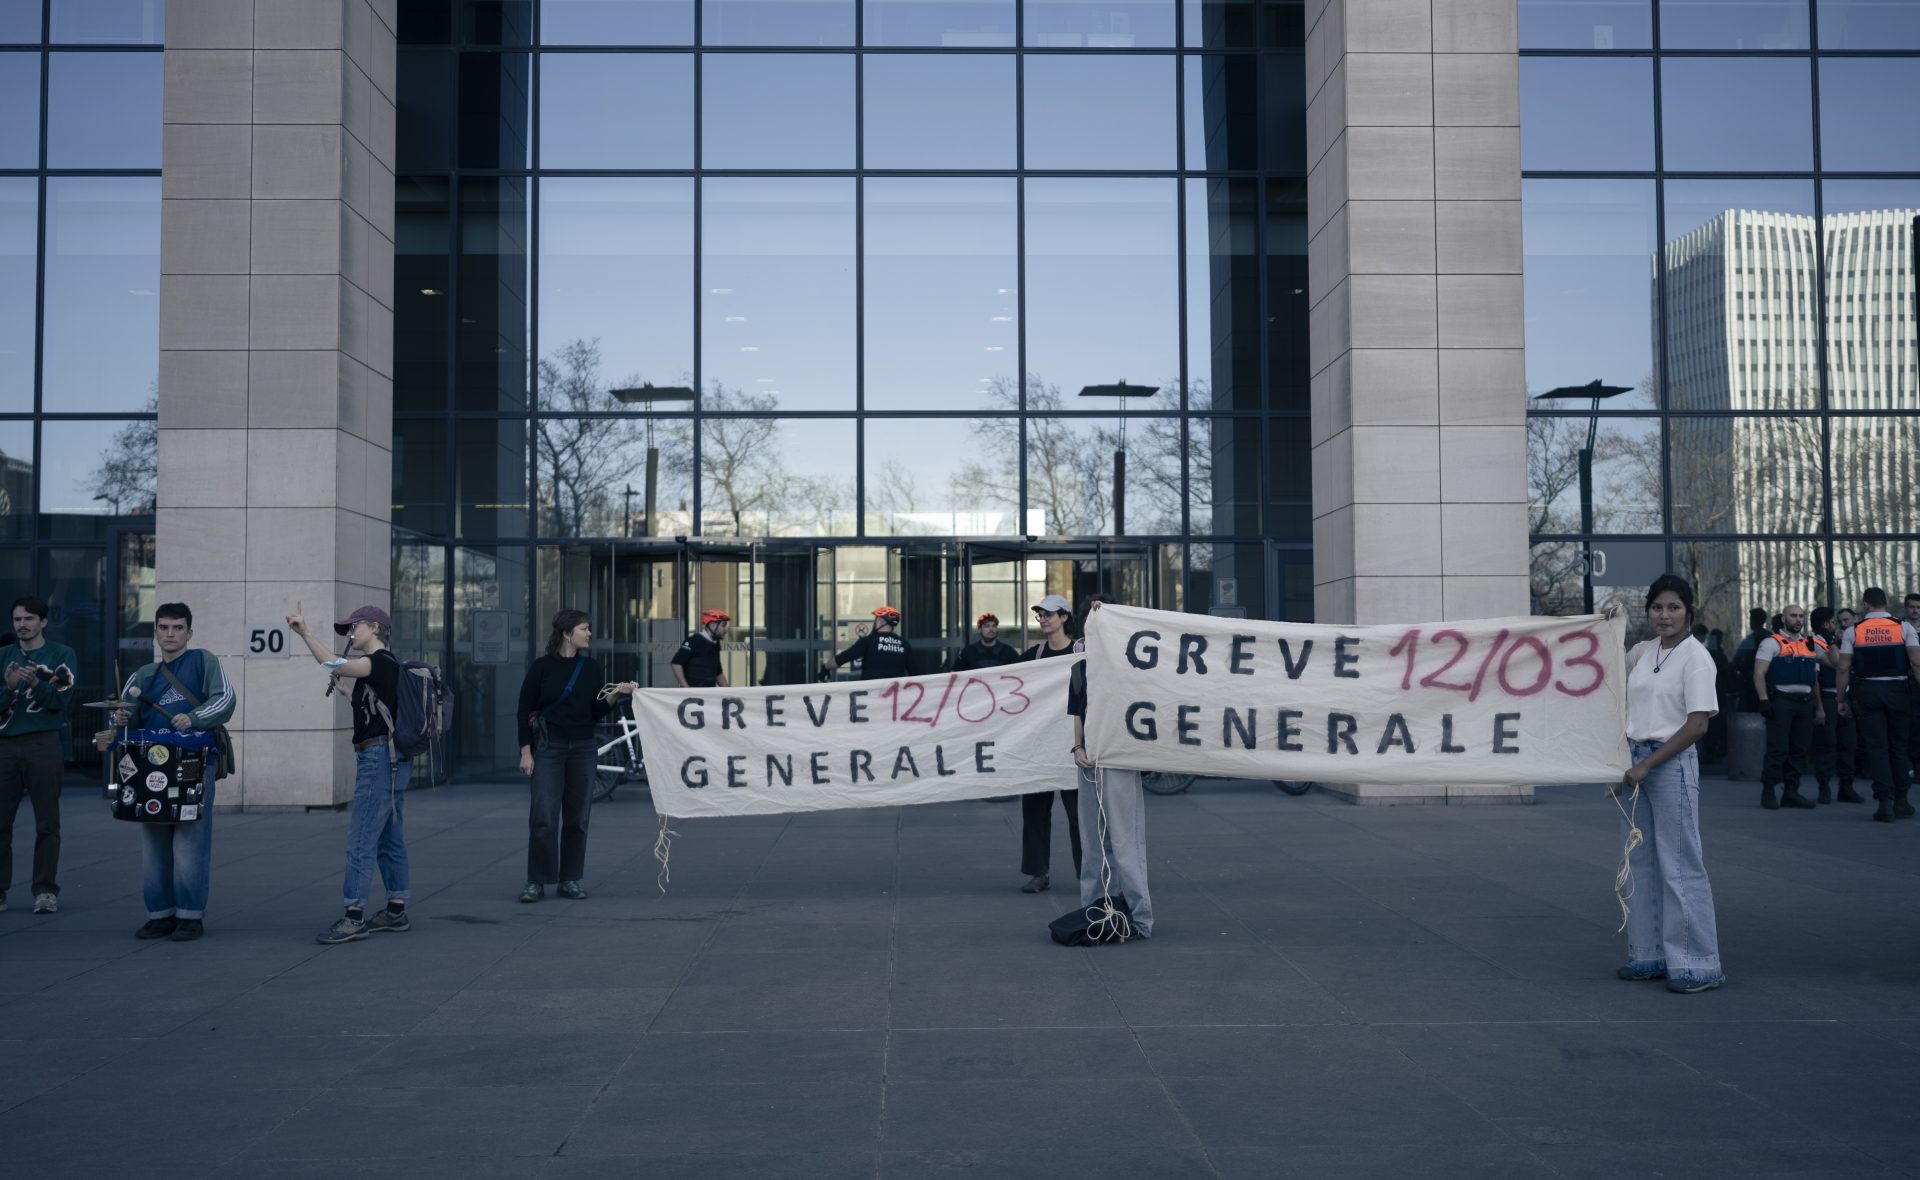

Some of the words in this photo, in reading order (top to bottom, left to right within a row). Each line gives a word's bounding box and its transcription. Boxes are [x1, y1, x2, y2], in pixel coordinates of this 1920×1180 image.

[1864, 634, 1892, 643] Politie
[1866, 627, 1890, 635] Police
[250, 629, 284, 653] 50
[878, 643, 905, 653] Politie
[879, 636, 902, 645] Police
[1124, 630, 1361, 679] GREVE
[1388, 628, 1606, 702] 12/03
[159, 693, 187, 705] adida
[676, 690, 870, 730] GREVE
[881, 673, 1031, 727] 12/03
[1124, 700, 1521, 755] GENERALE
[680, 740, 996, 788] GENERALE
